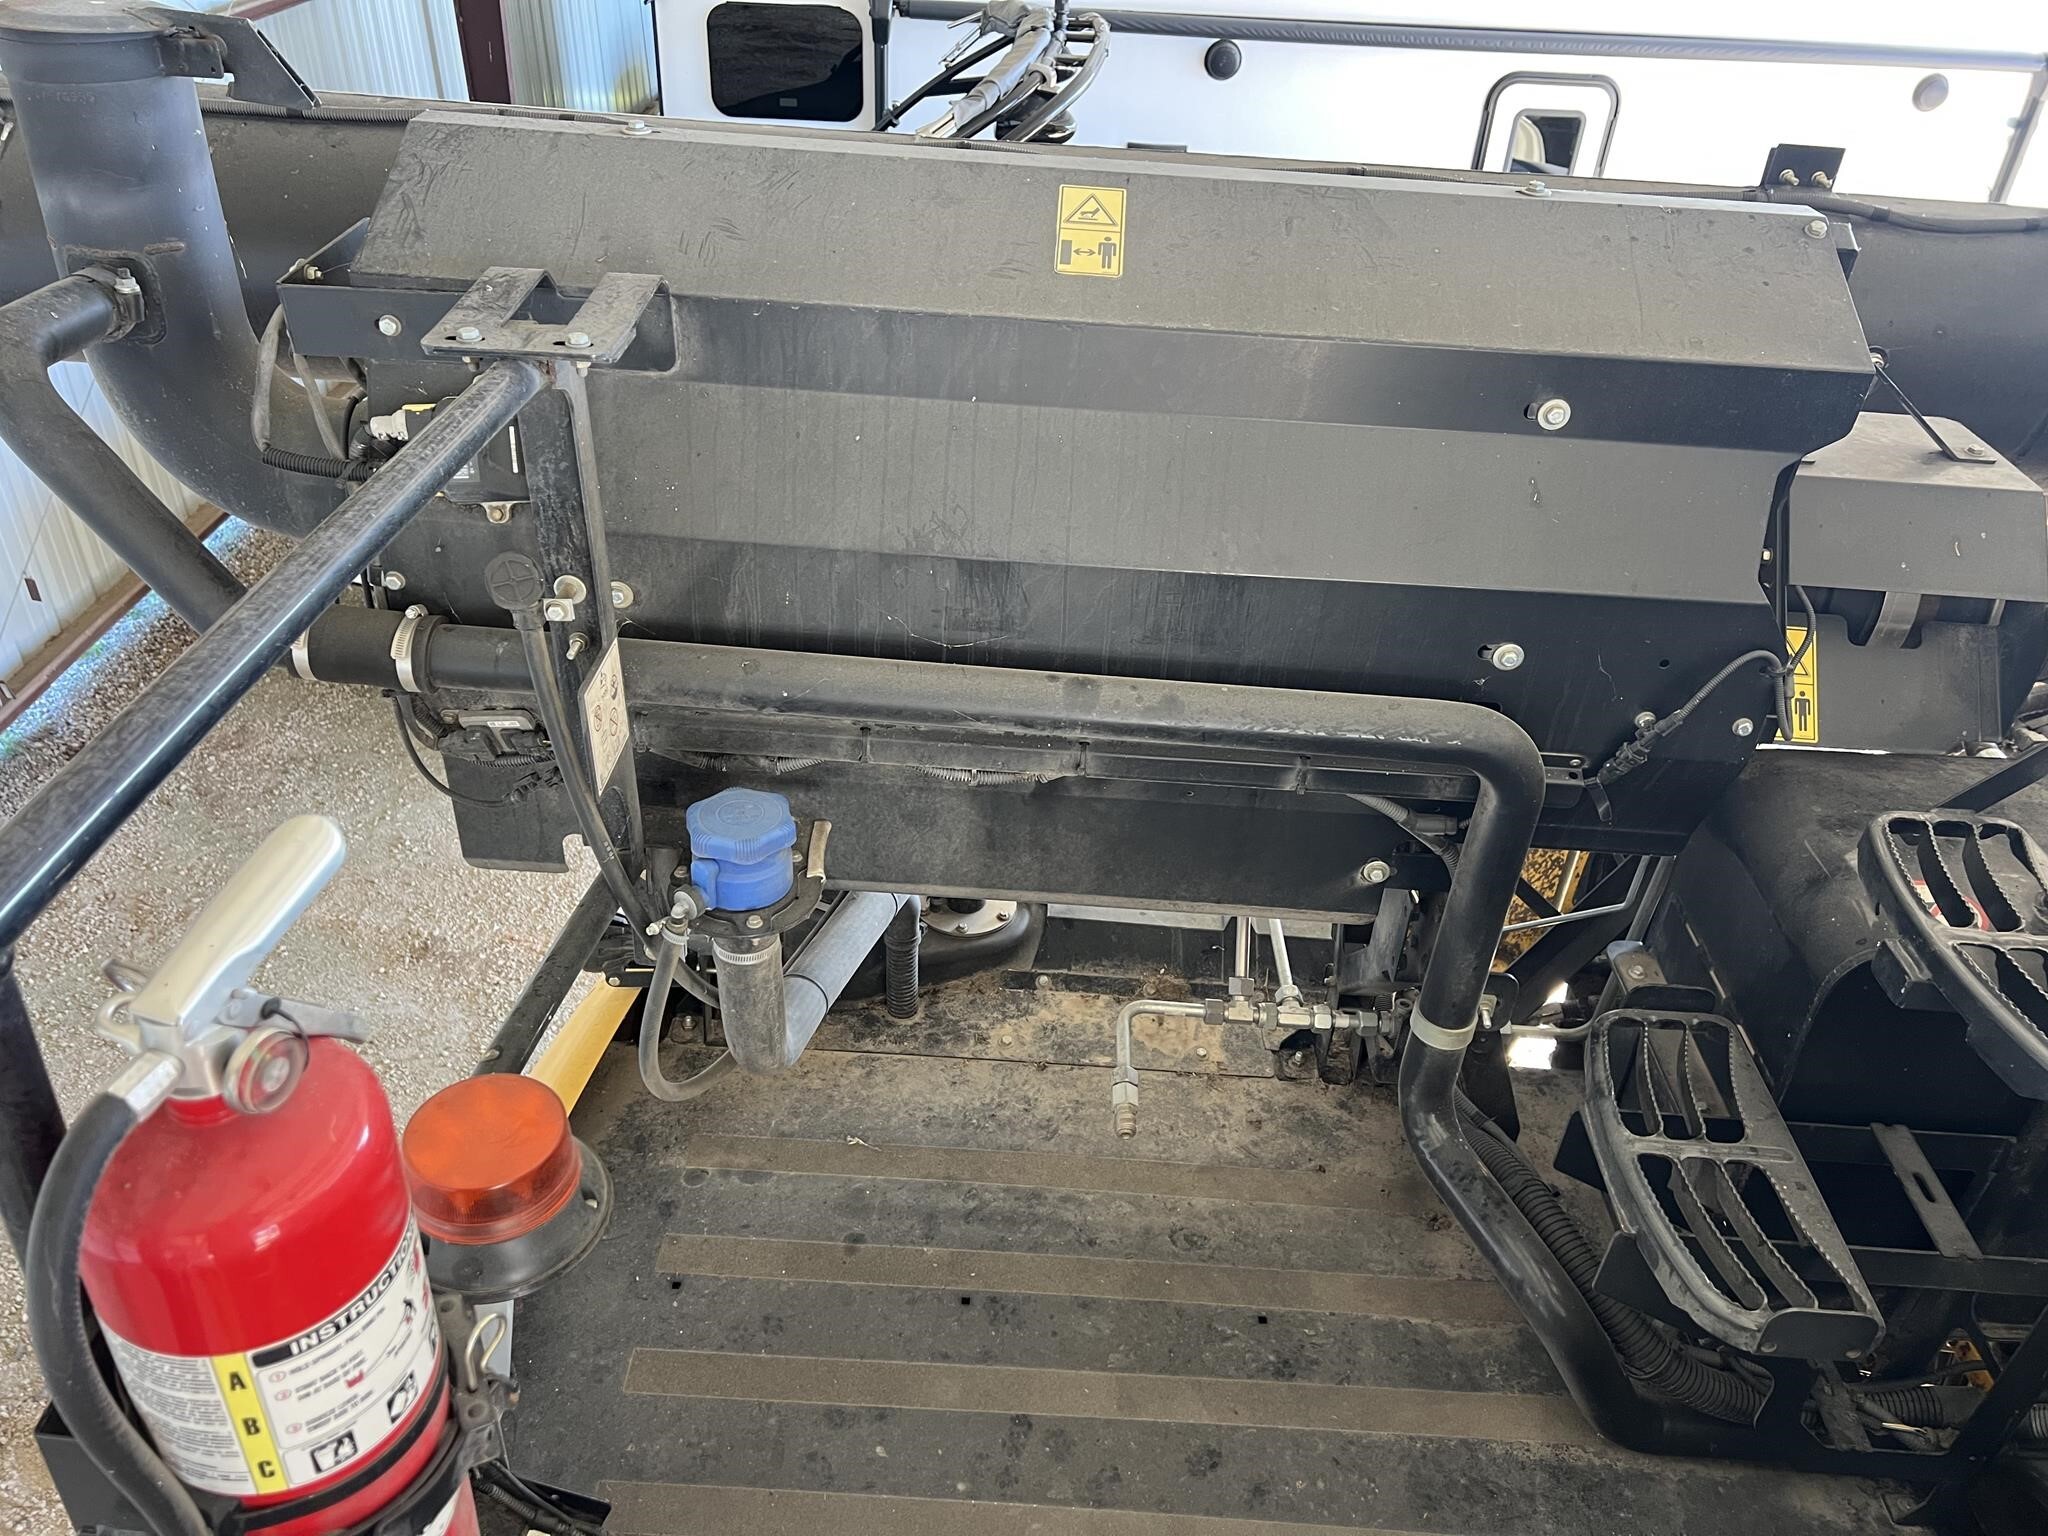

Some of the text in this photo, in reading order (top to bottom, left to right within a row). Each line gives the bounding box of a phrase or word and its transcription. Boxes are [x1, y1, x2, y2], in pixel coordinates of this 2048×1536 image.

[230, 1371, 247, 1391] A
[242, 1417, 261, 1436] B
[257, 1460, 275, 1478] C
